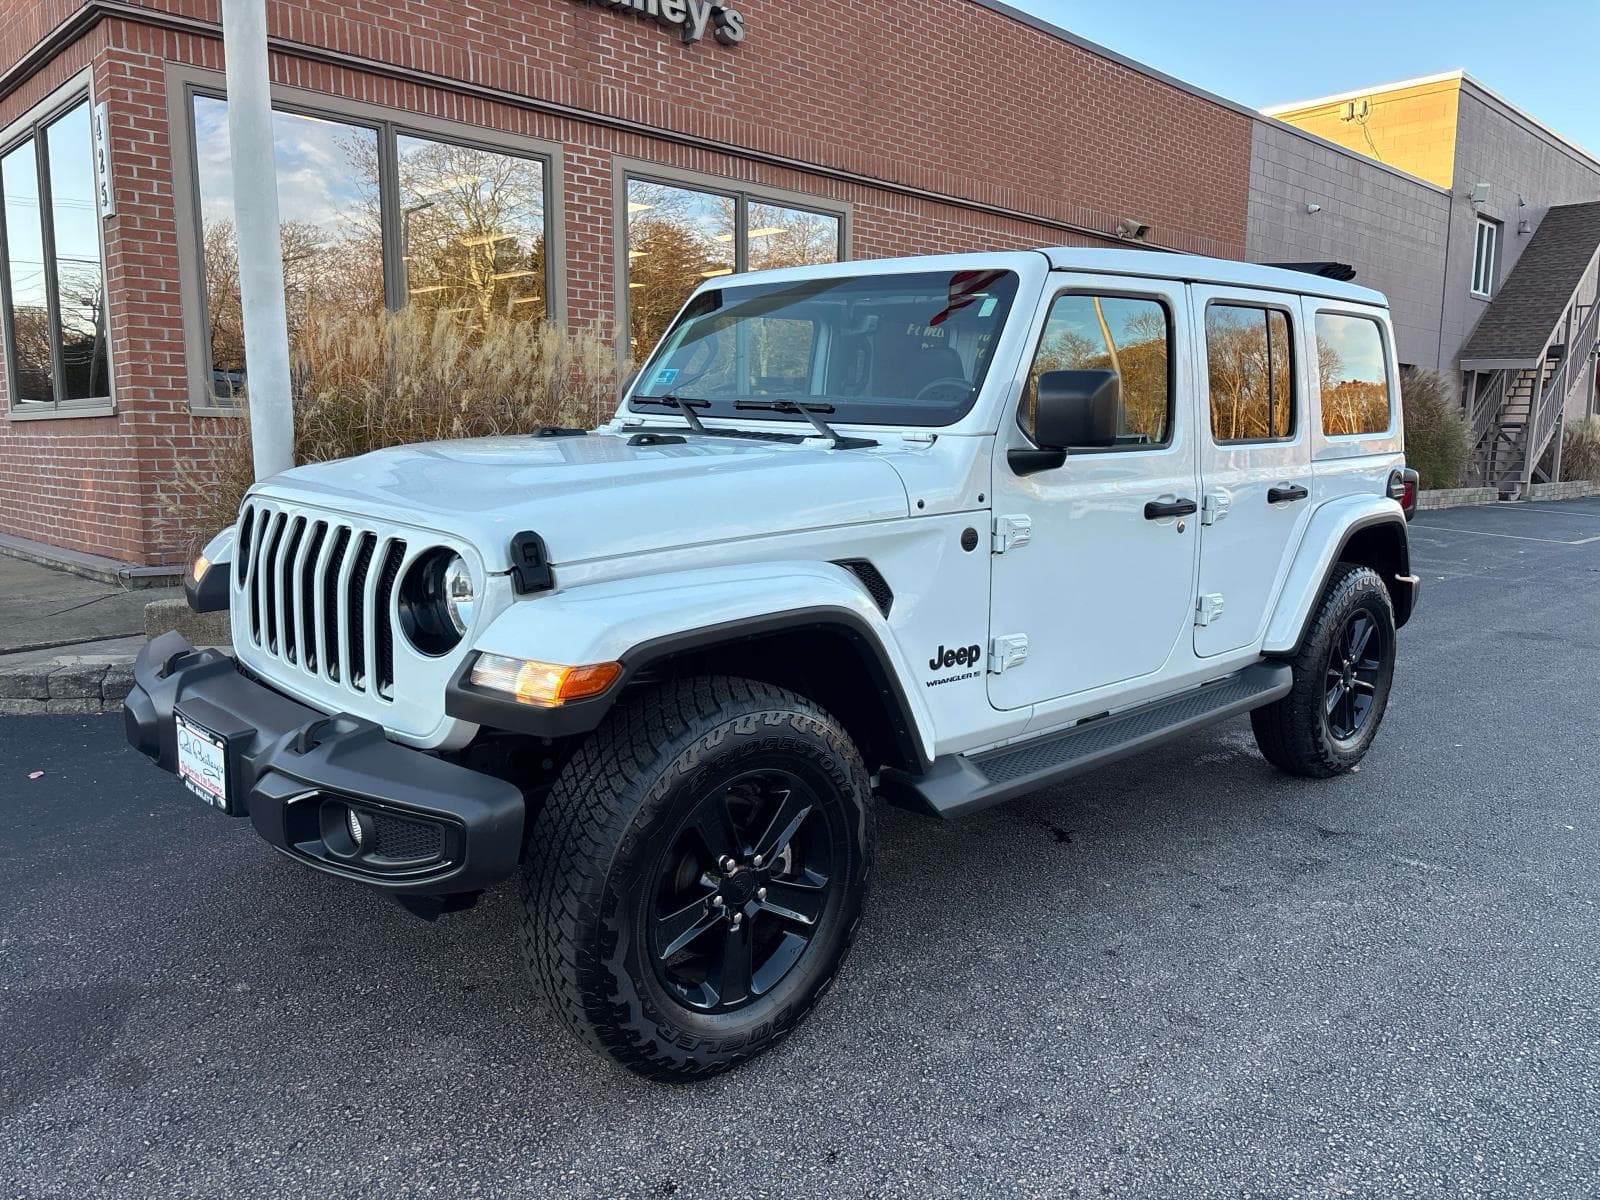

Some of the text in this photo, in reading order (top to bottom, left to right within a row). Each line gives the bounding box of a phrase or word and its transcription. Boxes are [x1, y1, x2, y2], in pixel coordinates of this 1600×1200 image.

[95, 114, 109, 207] 425
[929, 644, 980, 671] Jeep
[926, 672, 973, 688] WRANGLER
